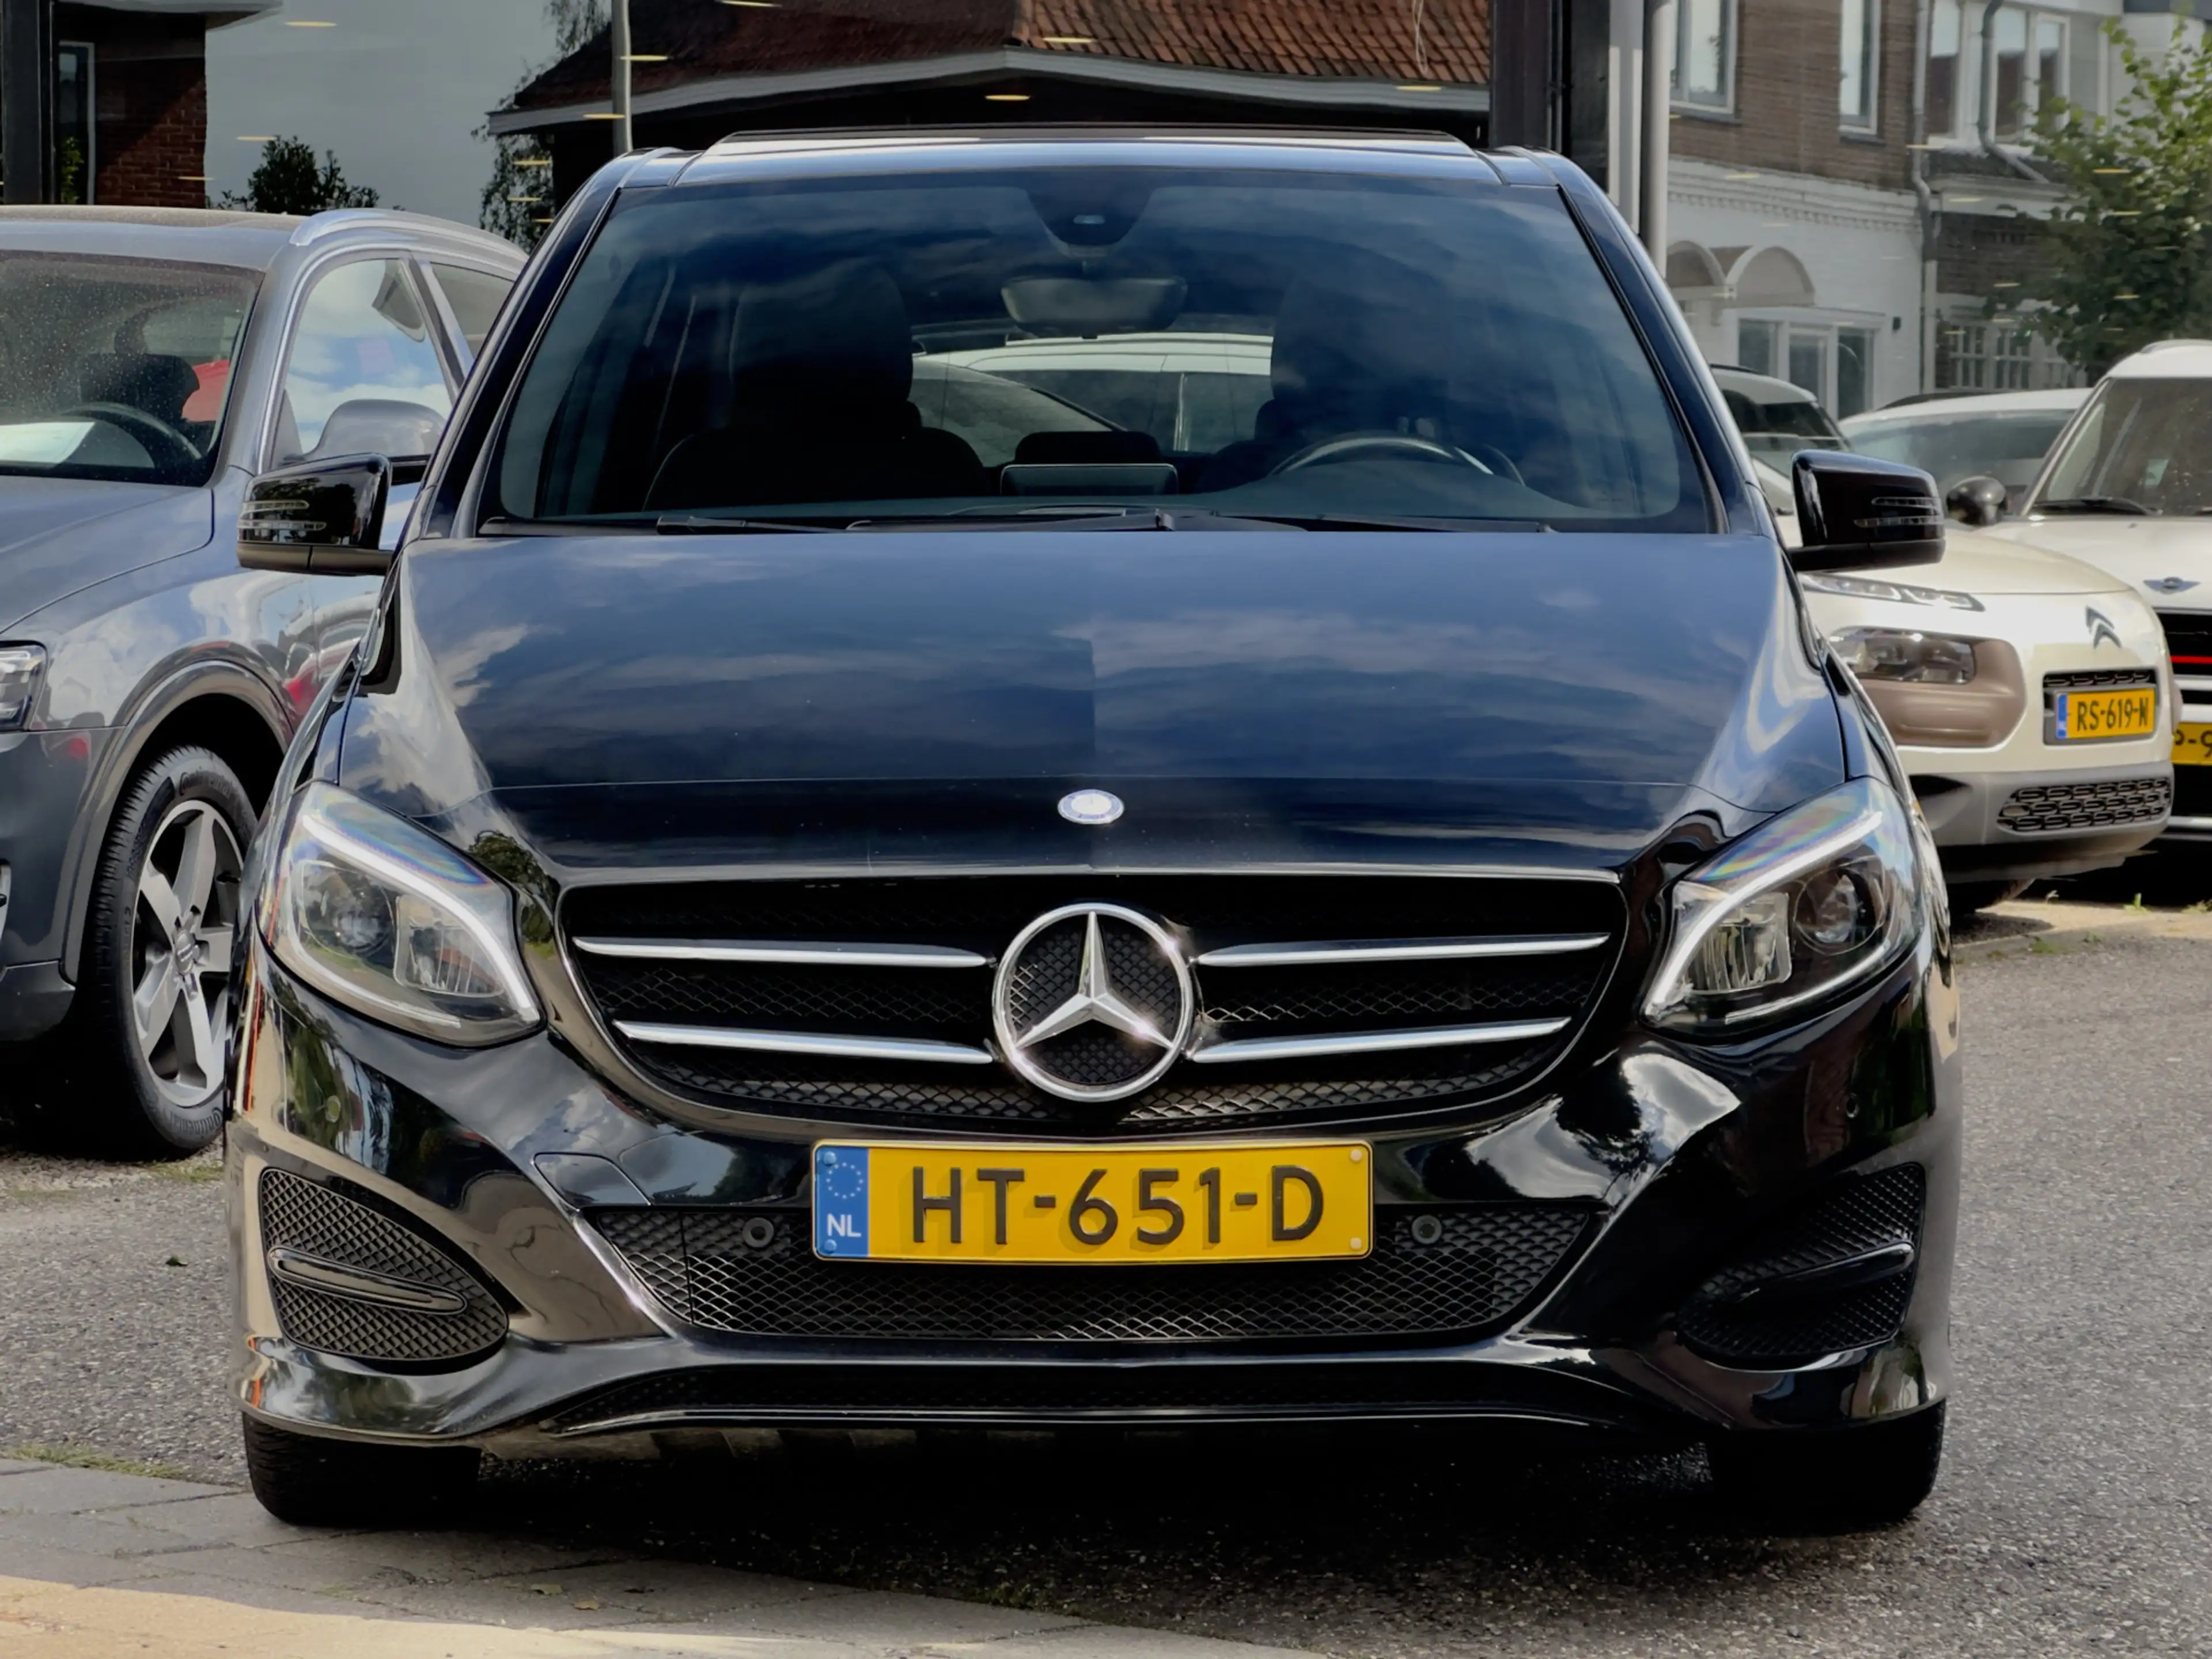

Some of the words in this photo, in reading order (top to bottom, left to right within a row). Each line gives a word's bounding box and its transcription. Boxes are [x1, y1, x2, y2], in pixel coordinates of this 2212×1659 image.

[2077, 697, 2149, 732] RS-619-N
[912, 1164, 1324, 1245] HT-651-D
[827, 1213, 861, 1237] NL
